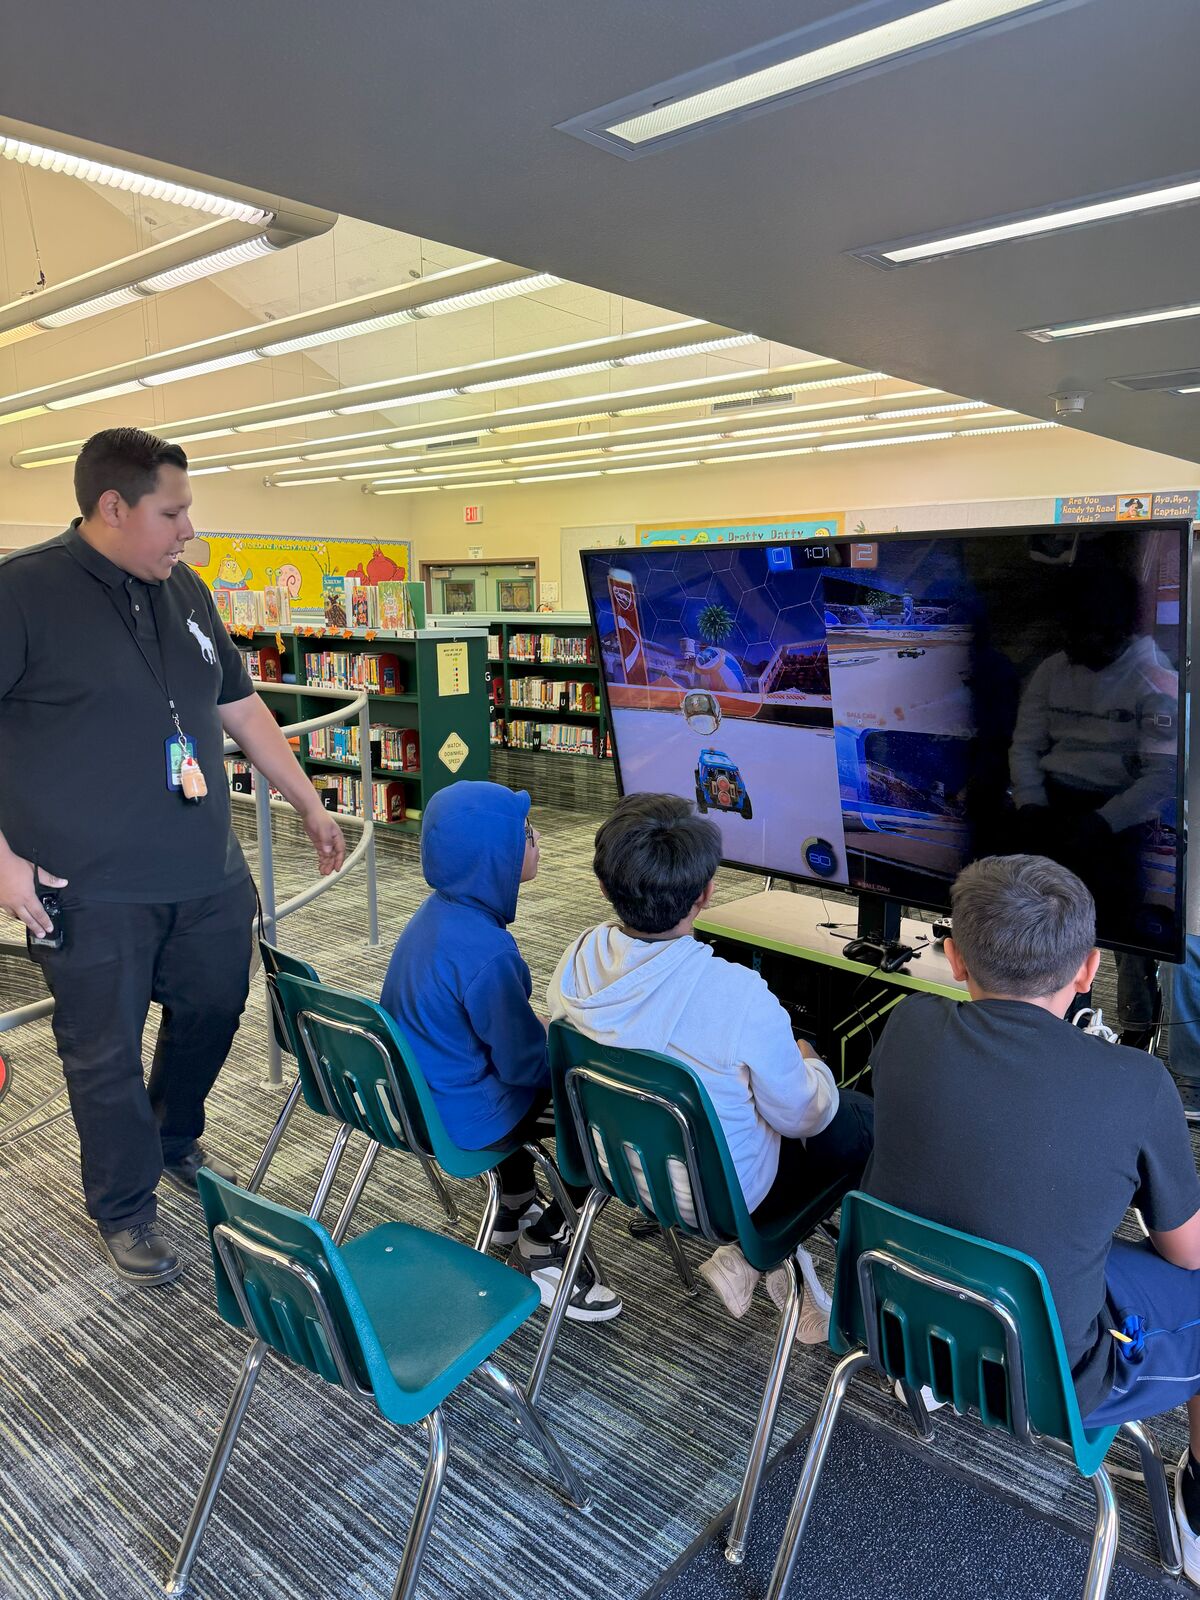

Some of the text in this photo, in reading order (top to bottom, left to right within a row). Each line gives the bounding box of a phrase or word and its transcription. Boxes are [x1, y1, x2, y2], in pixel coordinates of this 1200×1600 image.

[1084, 496, 1100, 504] You
[465, 506, 478, 521] EXIT
[1062, 504, 1116, 514] Ready to Read
[1153, 505, 1191, 517] Captain!
[804, 546, 830, 559] 1:01
[485, 672, 491, 682] G
[560, 698, 566, 706] U
[489, 706, 495, 714] P
[533, 737, 540, 745] W
[235, 782, 243, 791] D
[324, 797, 331, 807] F
